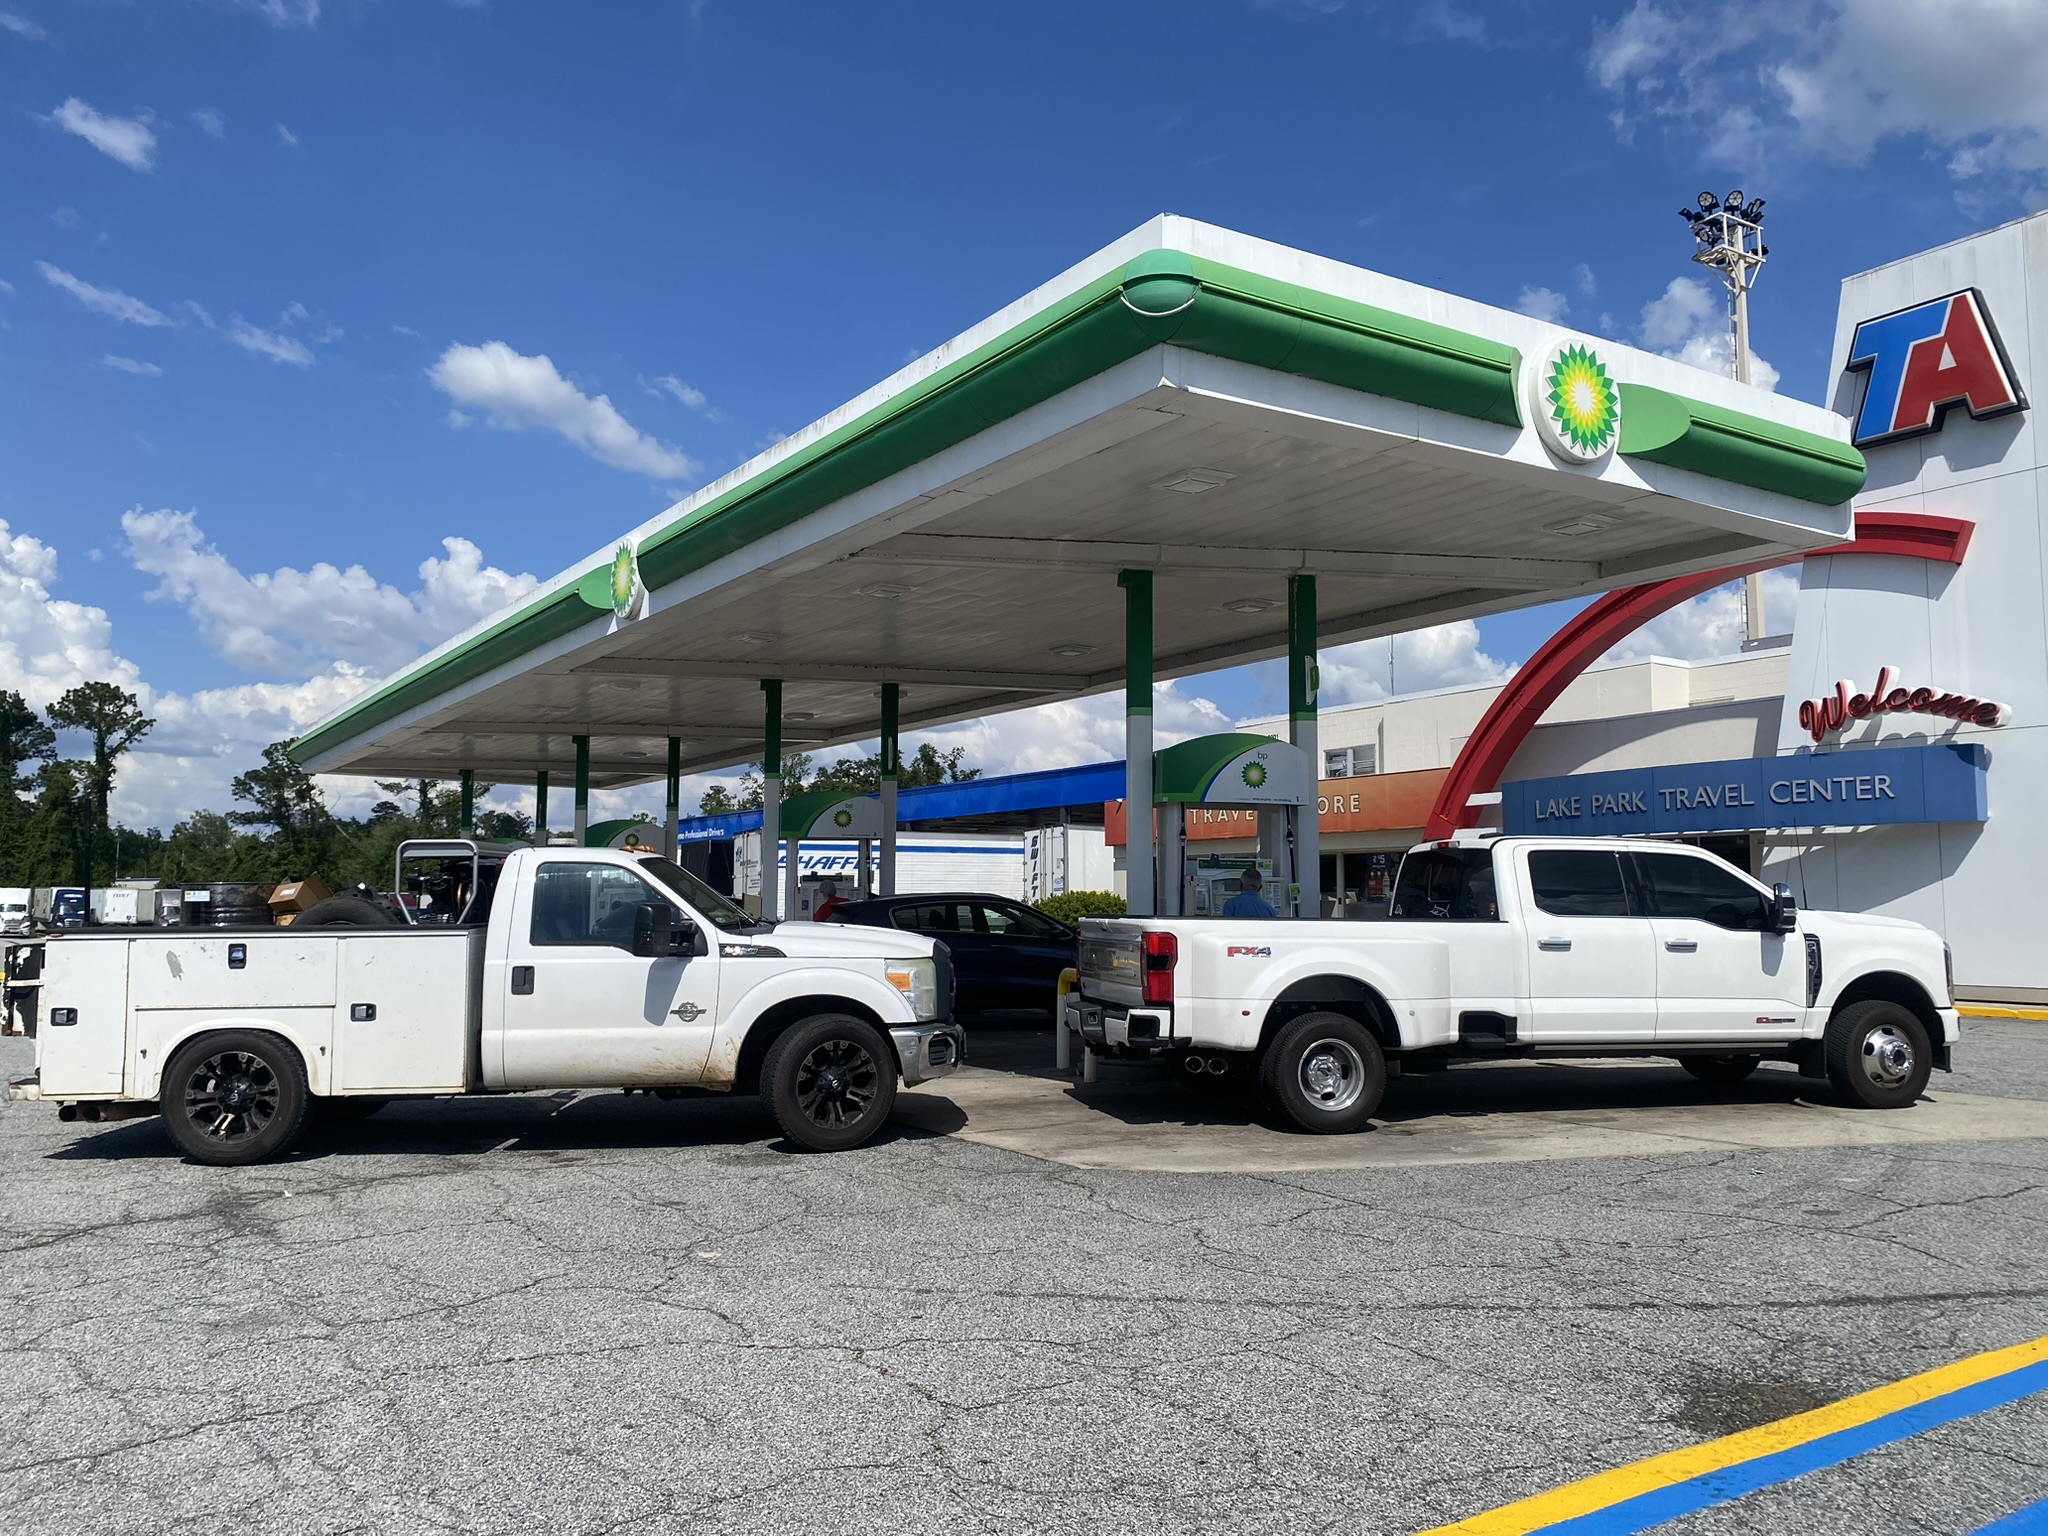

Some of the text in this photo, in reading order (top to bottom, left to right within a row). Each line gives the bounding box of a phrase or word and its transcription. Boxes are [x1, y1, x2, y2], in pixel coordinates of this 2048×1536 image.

[1850, 289, 2020, 445] TA
[1799, 666, 2004, 742] Welcome
[1257, 751, 1268, 760] bp
[1189, 794, 1361, 824] TRAVE ORE
[1535, 775, 1895, 819] LAKE PARK TRAVEL CENTER
[778, 856, 880, 869] SHAFF
[1030, 835, 1039, 897] SWIFT
[1227, 946, 1271, 957] FX4
